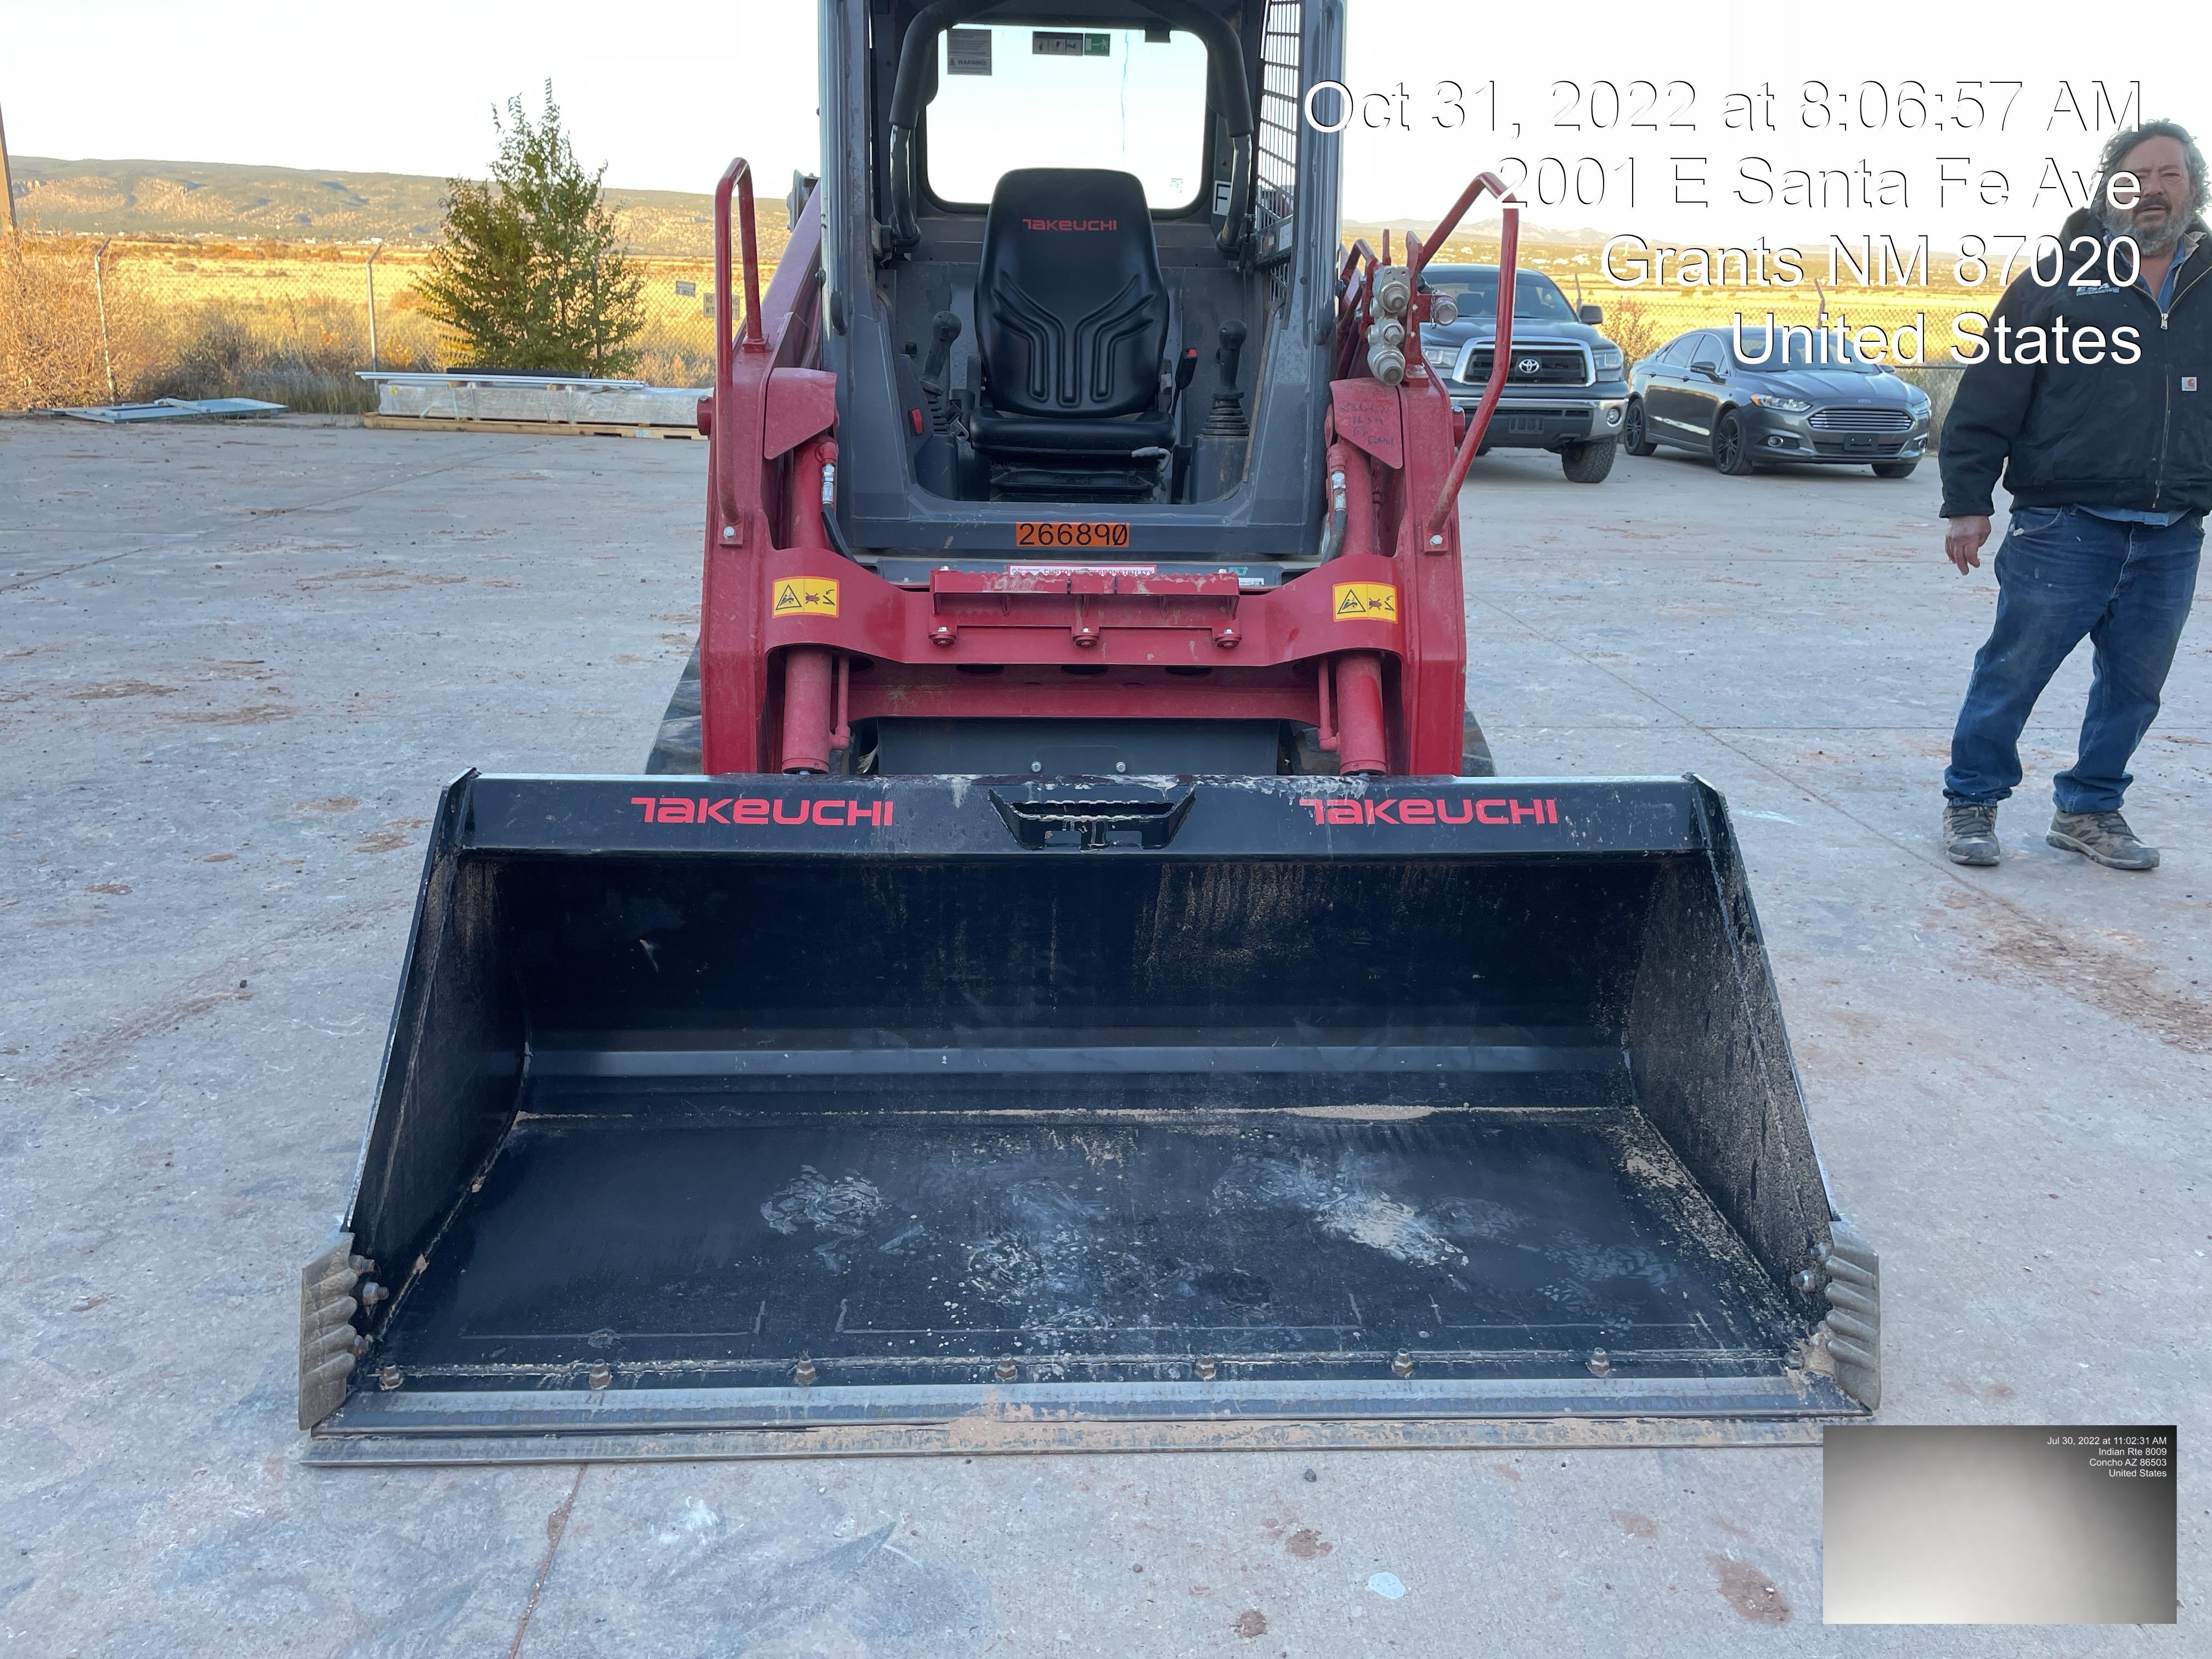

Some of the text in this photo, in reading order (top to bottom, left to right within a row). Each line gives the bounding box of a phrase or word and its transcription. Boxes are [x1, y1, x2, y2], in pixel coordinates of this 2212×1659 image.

[1023, 218, 1117, 231] TAKEUCHI
[1019, 523, 1127, 545] 266890
[631, 796, 1559, 826] TAKEUCHI TAKEUCHI
